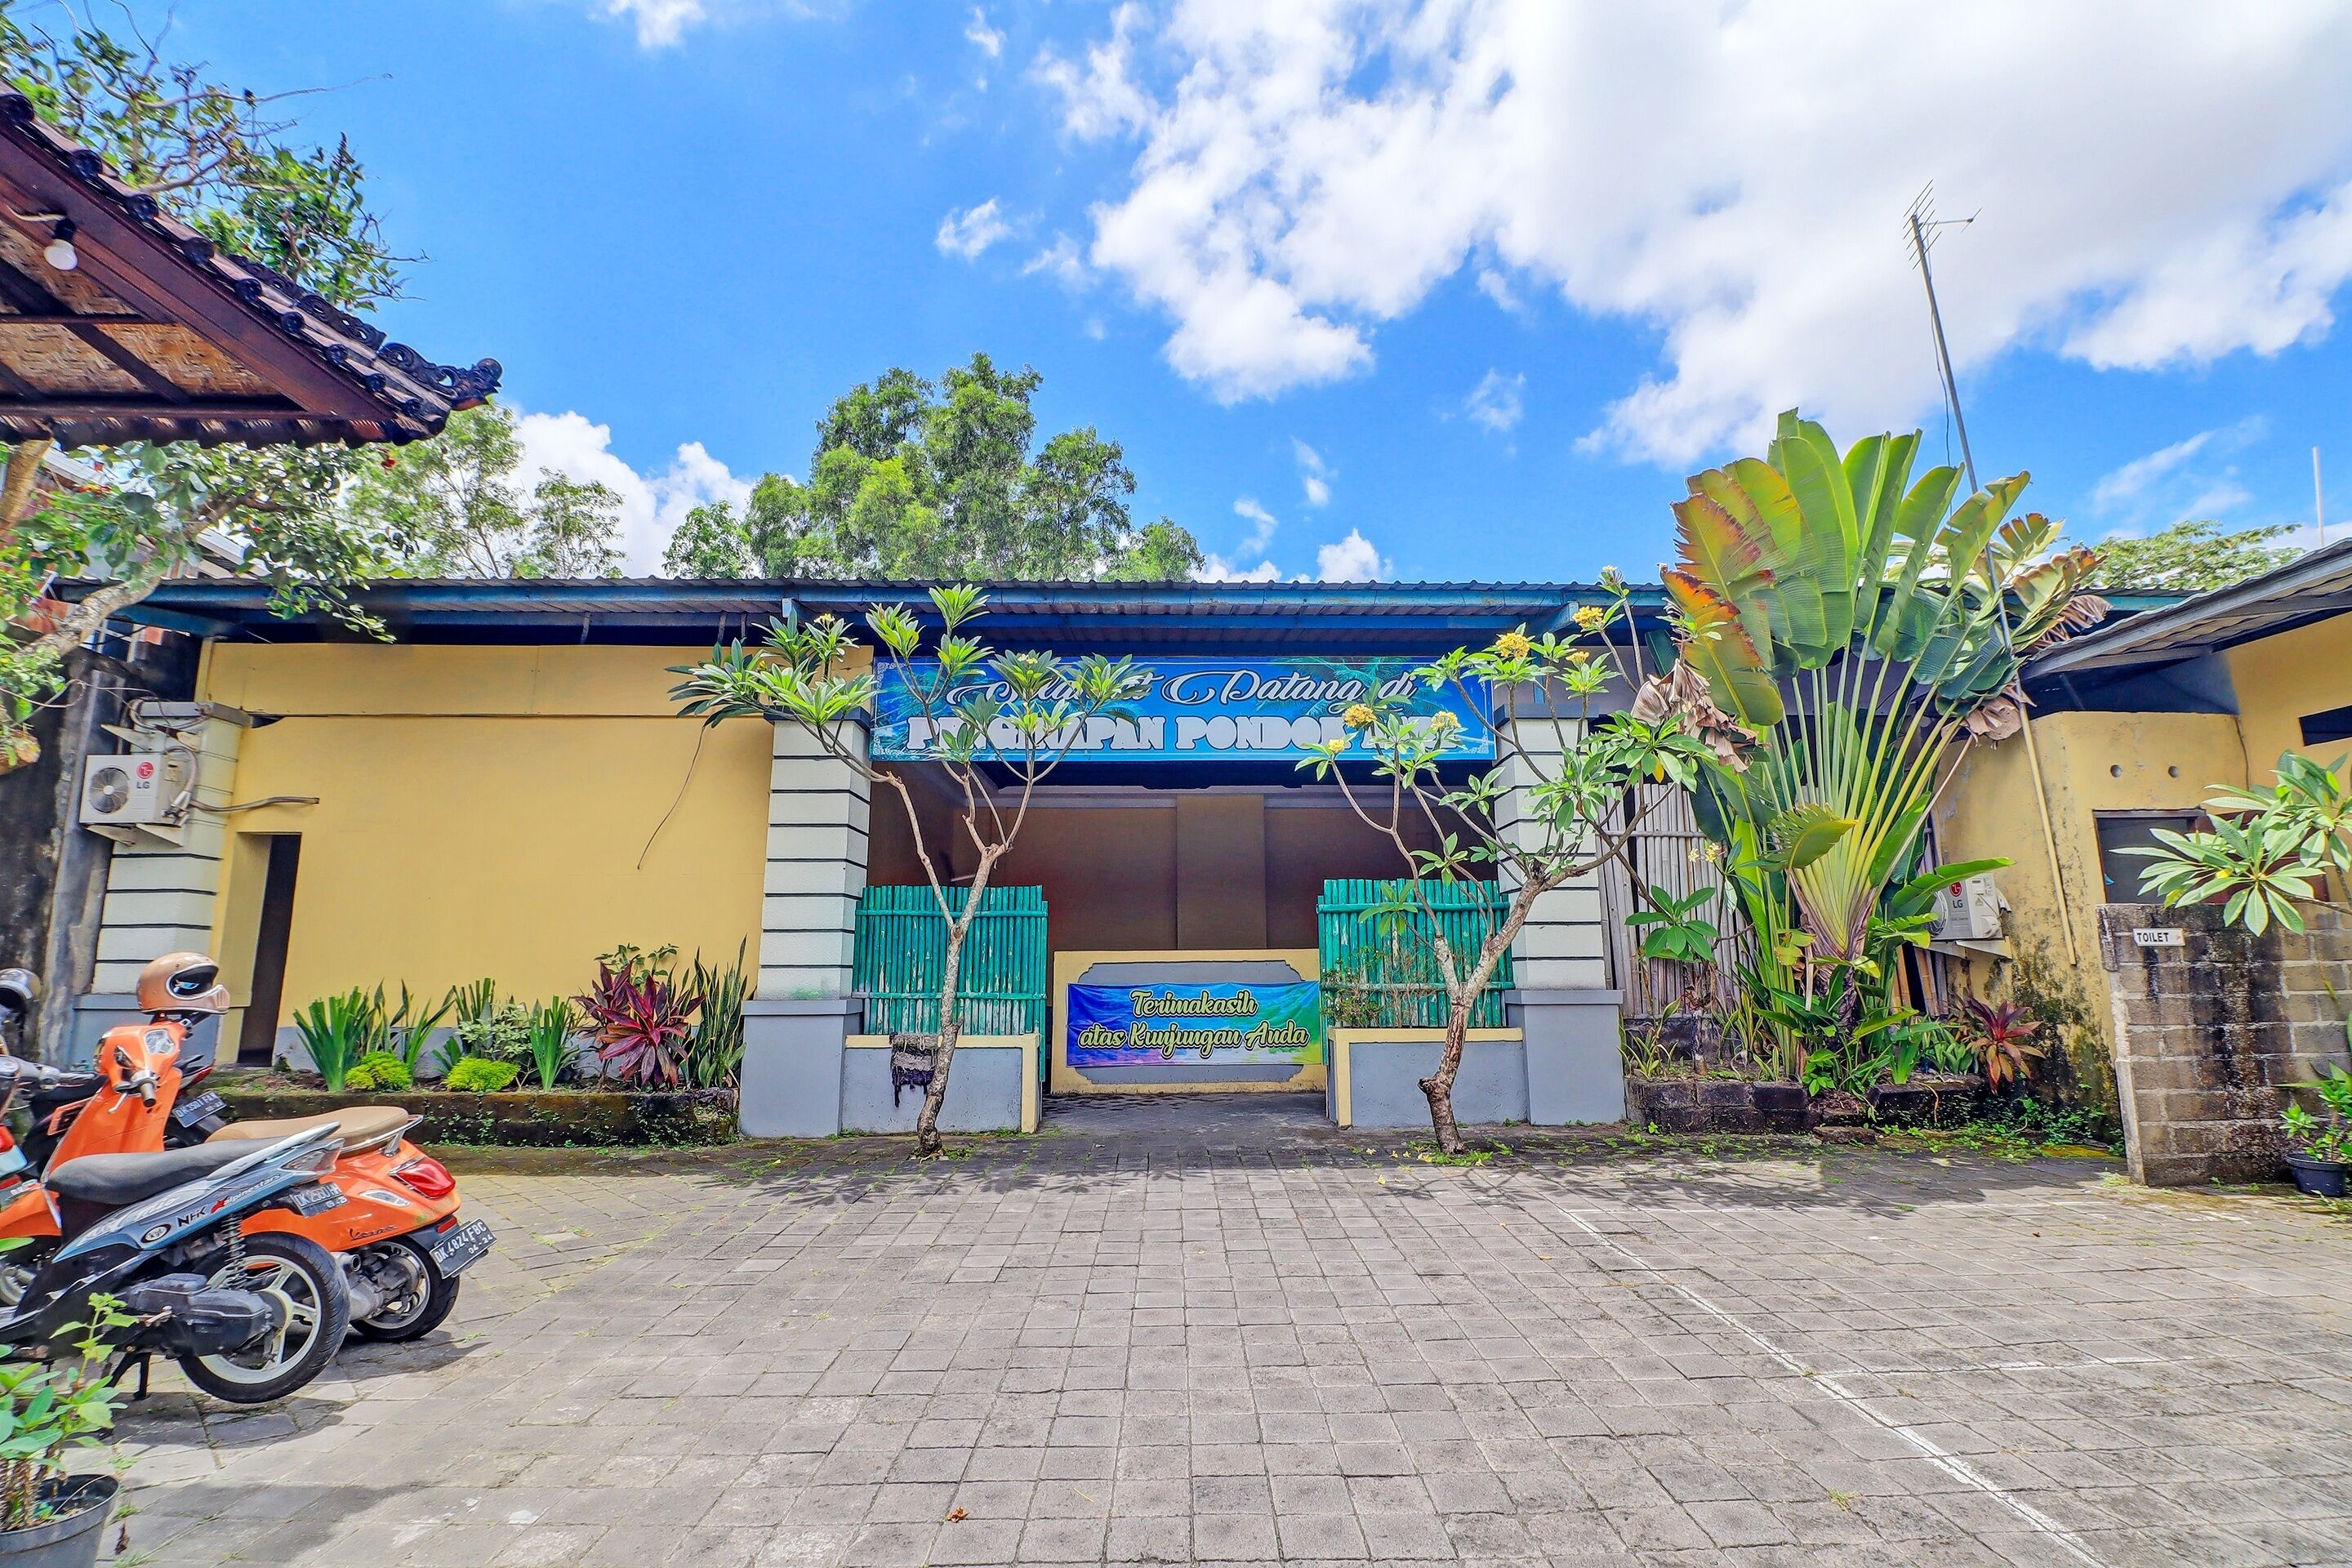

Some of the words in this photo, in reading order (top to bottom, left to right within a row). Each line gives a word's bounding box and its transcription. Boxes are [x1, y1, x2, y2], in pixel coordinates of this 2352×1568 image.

[1161, 669, 1369, 714] Datang
[1378, 670, 1418, 700] di
[1174, 715, 1352, 750] PONDOK
[136, 781, 150, 789] LG
[1952, 899, 1963, 909] LG
[2136, 933, 2169, 942] TOILET
[1130, 990, 1258, 1016] Terimakasih
[1079, 1024, 1125, 1047] atas
[1129, 1022, 1241, 1058] Kunjungan
[1246, 1020, 1307, 1049] Anda
[293, 1192, 310, 1207] DK
[176, 1205, 207, 1228] NHK
[434, 1246, 449, 1263] DK
[447, 1232, 470, 1253] 4824
[466, 1222, 487, 1240] FBC
[468, 1234, 493, 1254] 04-24
